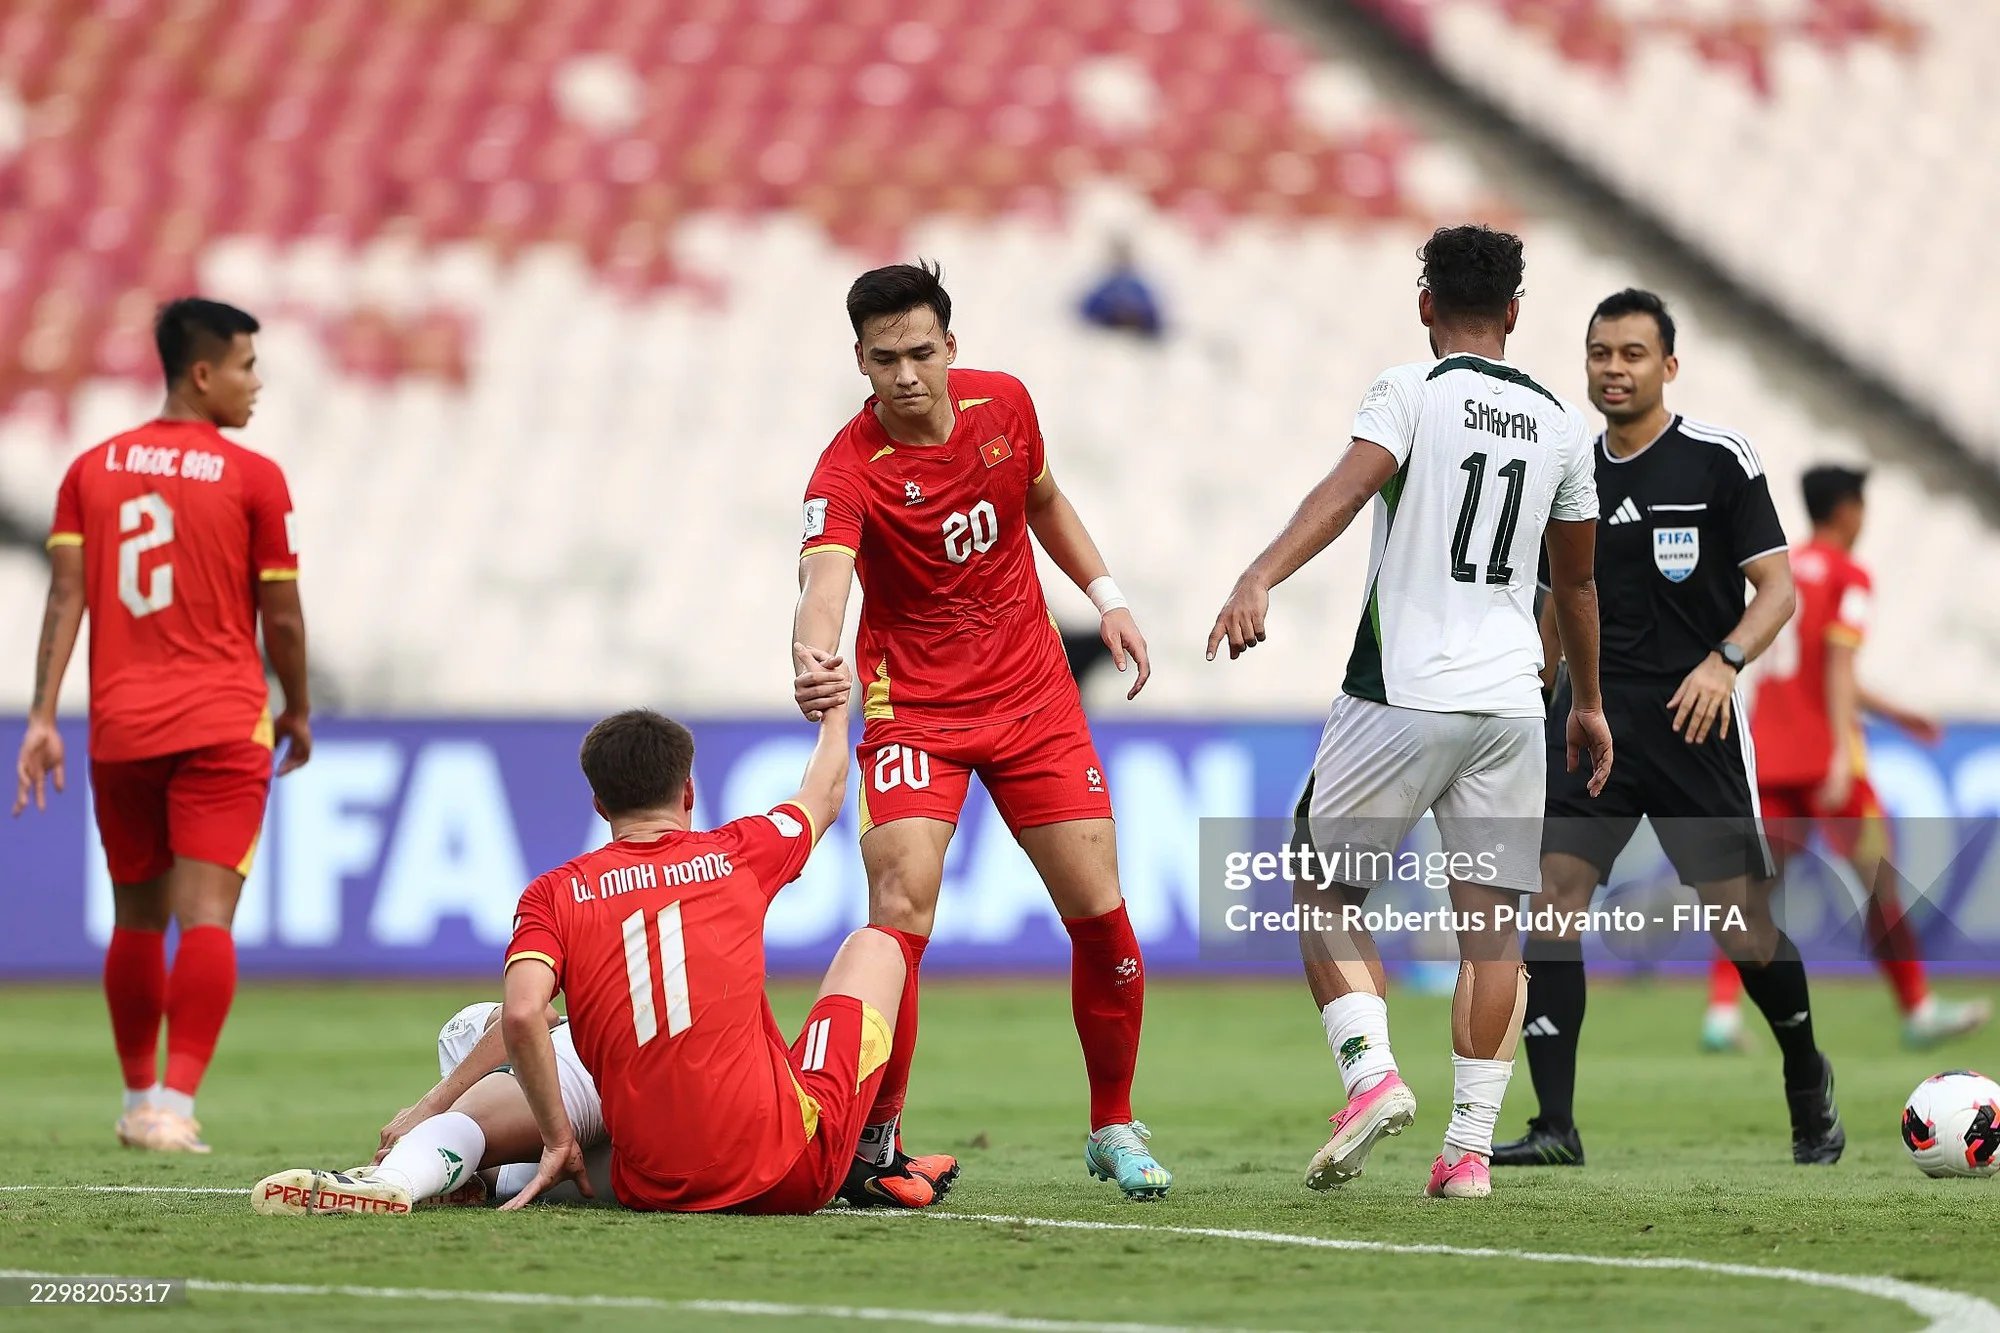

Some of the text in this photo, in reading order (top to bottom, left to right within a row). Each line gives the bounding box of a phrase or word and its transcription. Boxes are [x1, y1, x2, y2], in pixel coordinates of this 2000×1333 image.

[1464, 399, 1538, 443] SHAYAK
[125, 444, 180, 477] NGOC
[941, 500, 998, 564] 20
[1450, 452, 1527, 585] 11
[1658, 532, 1694, 545] FIFA
[118, 492, 174, 618] 2
[1658, 552, 1694, 560] REFEREE
[873, 743, 931, 793] 20
[600, 863, 658, 899] MINH
[661, 852, 734, 887] HOANG
[621, 899, 693, 1048] 11
[801, 1017, 831, 1071] 11
